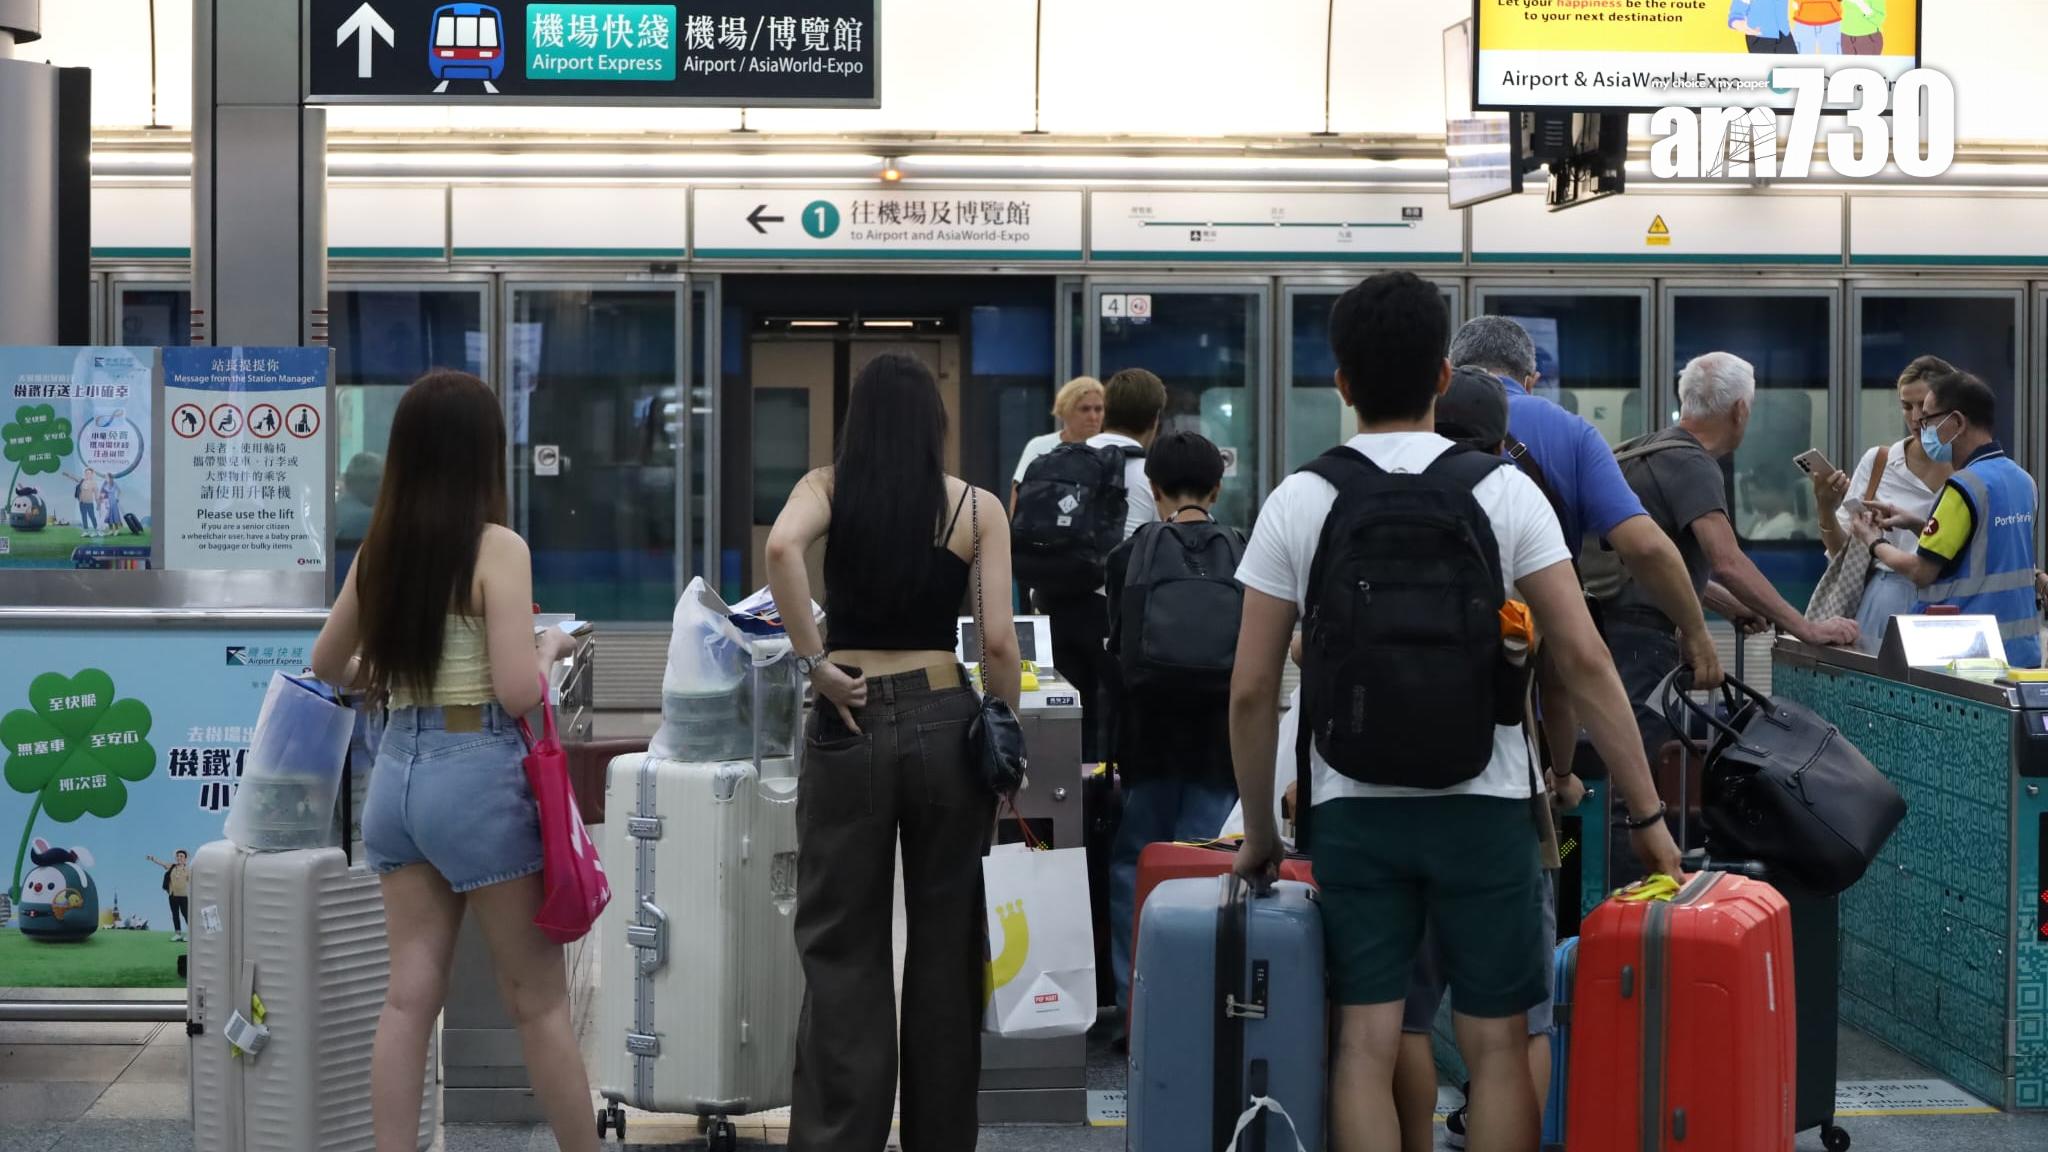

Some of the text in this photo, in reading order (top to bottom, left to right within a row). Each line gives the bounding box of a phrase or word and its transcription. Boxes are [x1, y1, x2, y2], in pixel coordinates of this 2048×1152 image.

[1557, 0, 1622, 9] happiness
[1626, 0, 1641, 8] be
[1646, 0, 1667, 8] the
[1670, 1, 1706, 10] route
[1525, 12, 1683, 23] to your next destination
[532, 13, 669, 50] 機場快綫
[684, 15, 862, 53] 機場/博覽館
[532, 53, 662, 74] Airport Express
[684, 55, 737, 75] Airport
[749, 55, 863, 76] AsiaWorld-Expo
[1502, 70, 1569, 90] Airport
[1574, 72, 1588, 87] &
[851, 199, 1031, 226] 往機場及博覽館
[851, 230, 1030, 243] to Airport and AsiaWorld-Expo
[1108, 298, 1119, 314] 4
[211, 358, 280, 372] 站長提提你
[174, 374, 315, 385] Message from the Station Manager
[205, 470, 288, 482] 大型物件的乘客
[200, 485, 292, 500] 請使用升降機
[197, 509, 295, 520] Please use the lift
[271, 533, 289, 541] baby
[208, 543, 240, 551] baggage
[250, 542, 271, 551] bulky
[248, 657, 303, 666] Airport Express
[48, 692, 97, 712] 至快脆
[17, 738, 66, 756] 無塞車
[89, 729, 140, 749] 至安心
[59, 774, 108, 793] 班次密
[199, 782, 239, 811] 小
